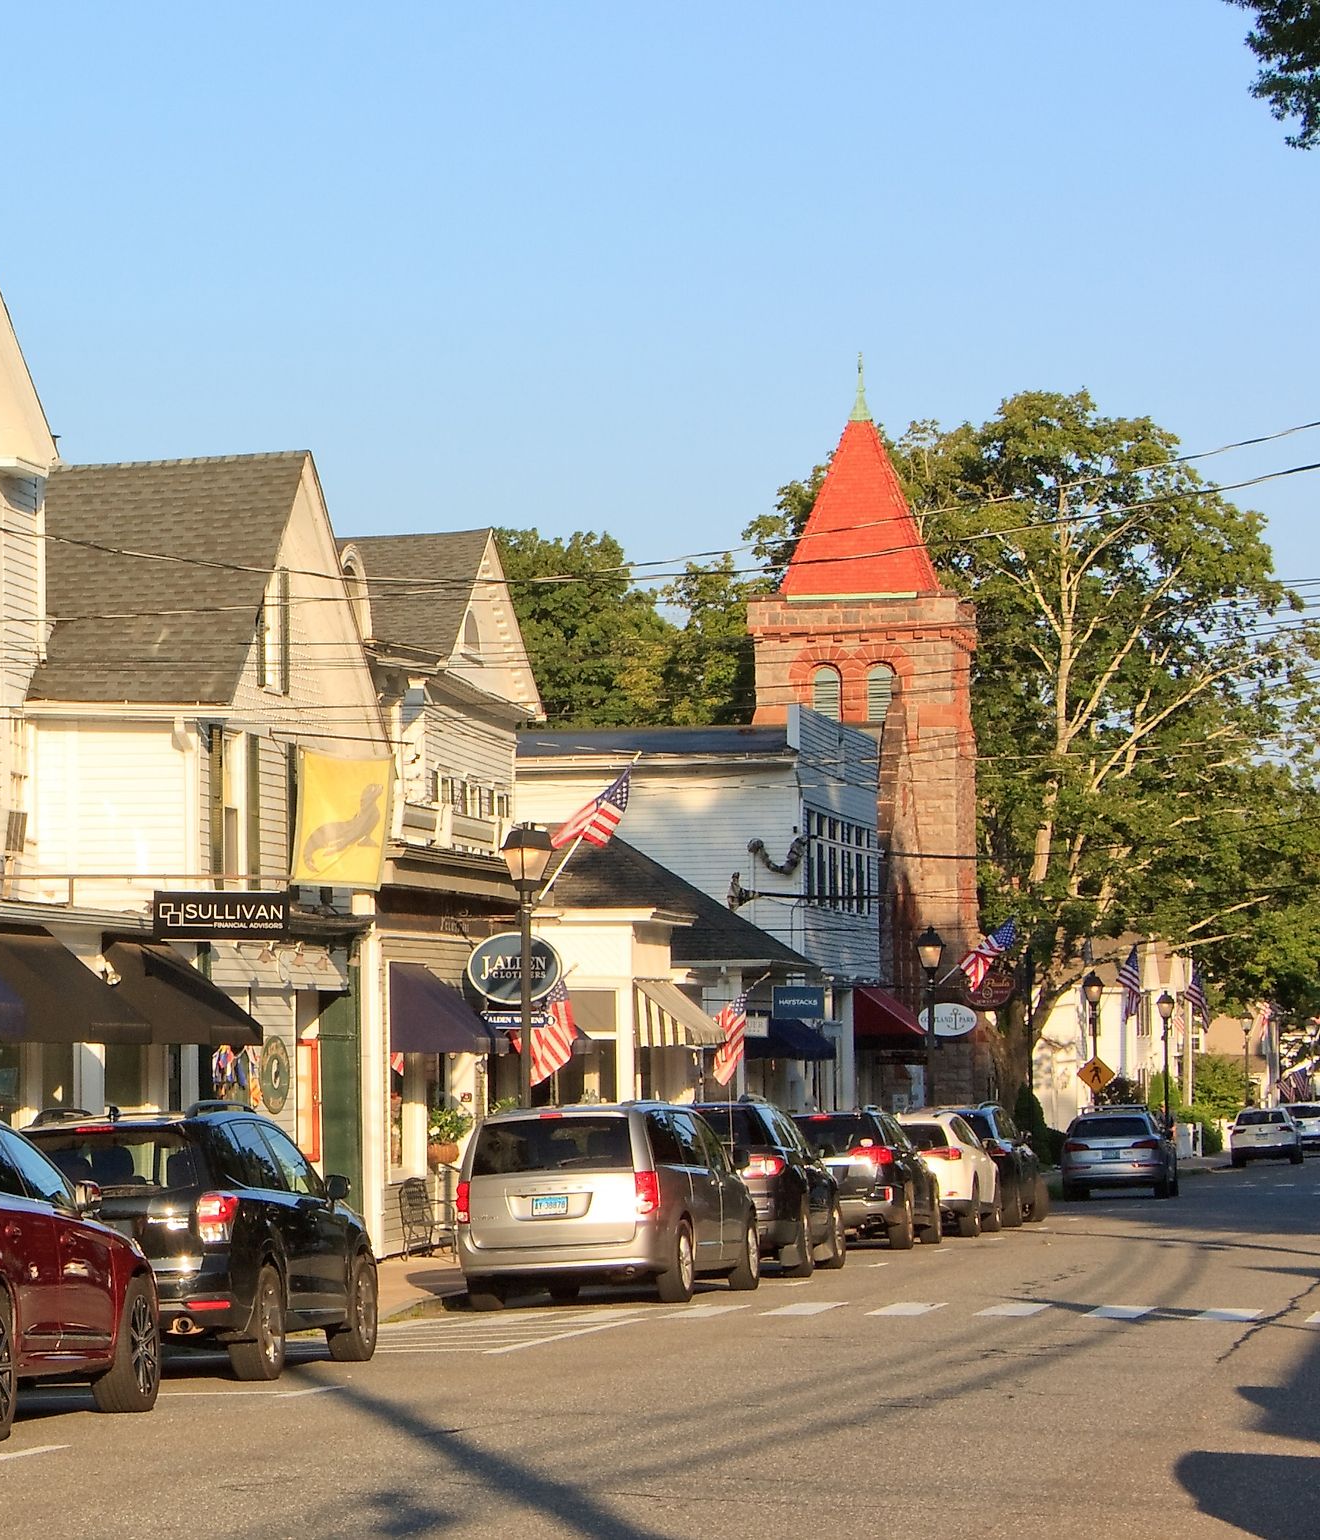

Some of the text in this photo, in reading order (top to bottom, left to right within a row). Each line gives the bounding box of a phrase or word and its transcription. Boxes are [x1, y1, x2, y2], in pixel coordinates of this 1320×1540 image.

[185, 903, 283, 920] SULLIVAN
[213, 921, 283, 929] FINANCIAL ADVISORS
